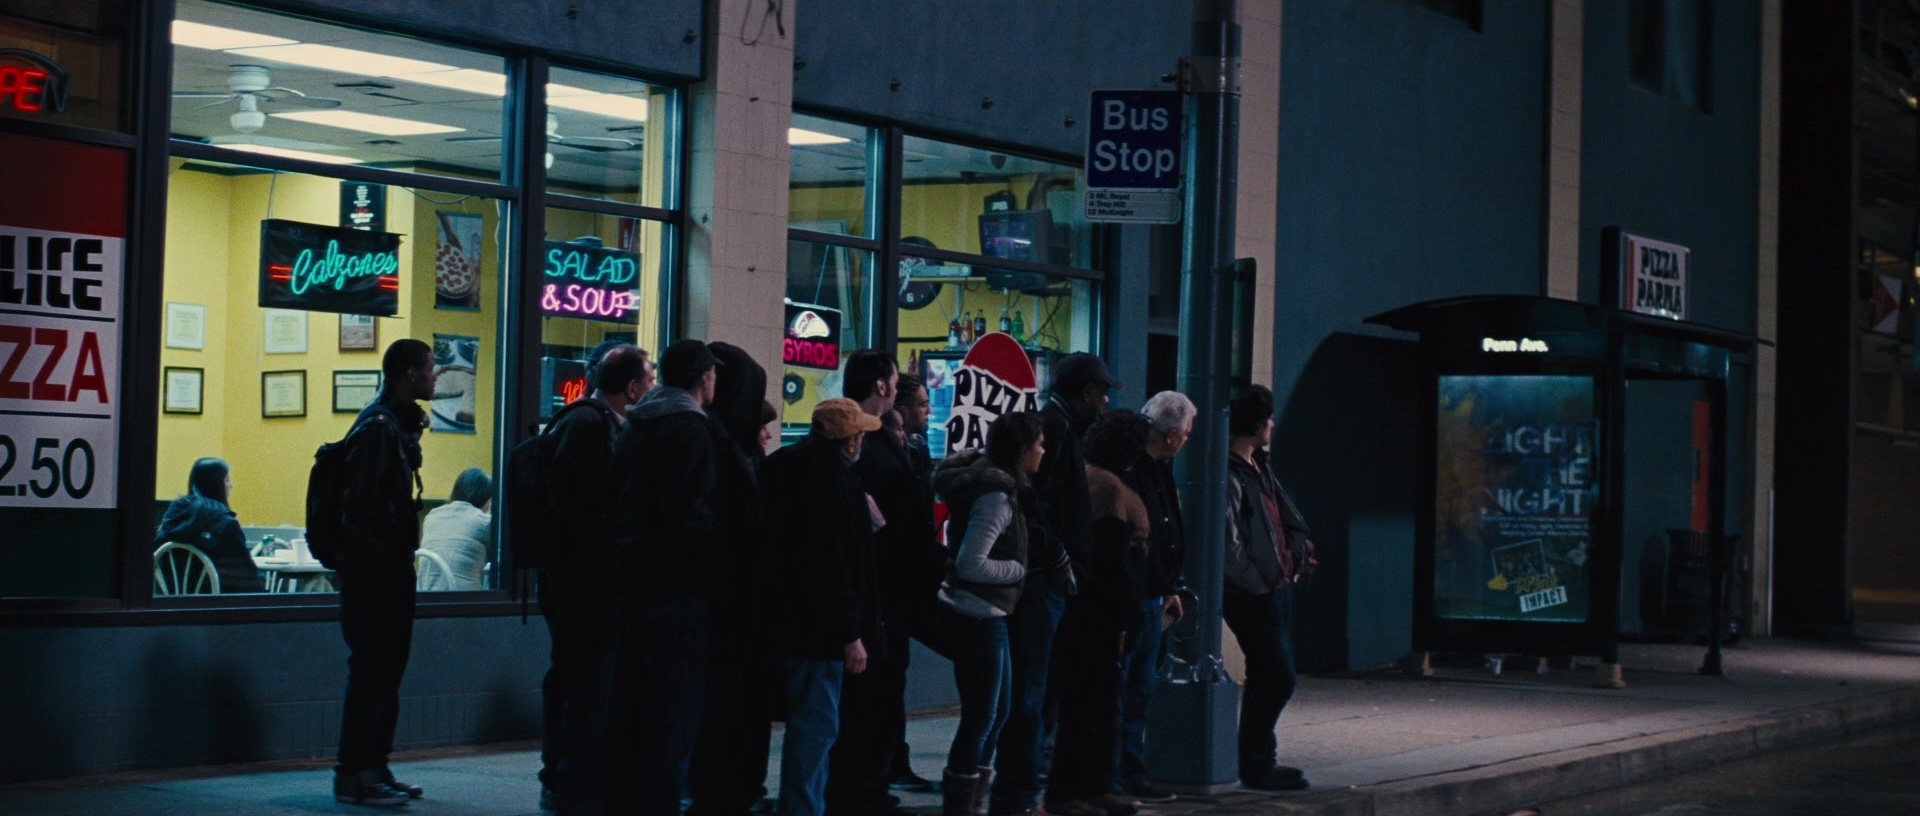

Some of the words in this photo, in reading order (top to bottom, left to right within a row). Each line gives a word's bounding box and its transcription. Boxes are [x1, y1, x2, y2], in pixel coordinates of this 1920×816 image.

[1103, 99, 1168, 131] Bus
[1093, 140, 1175, 178] Stop
[291, 239, 398, 295] Calzones
[545, 249, 636, 283] SALAD
[1639, 246, 1680, 280] PIZZA
[542, 284, 560, 312] &
[1636, 278, 1683, 313] PARMA
[783, 338, 838, 367] GYROS
[1482, 337, 1517, 352] Penn
[1520, 337, 1549, 352] Ave.
[953, 368, 1040, 415] PIZZA
[945, 413, 992, 454] PA
[1524, 588, 1563, 610] IMPACT
